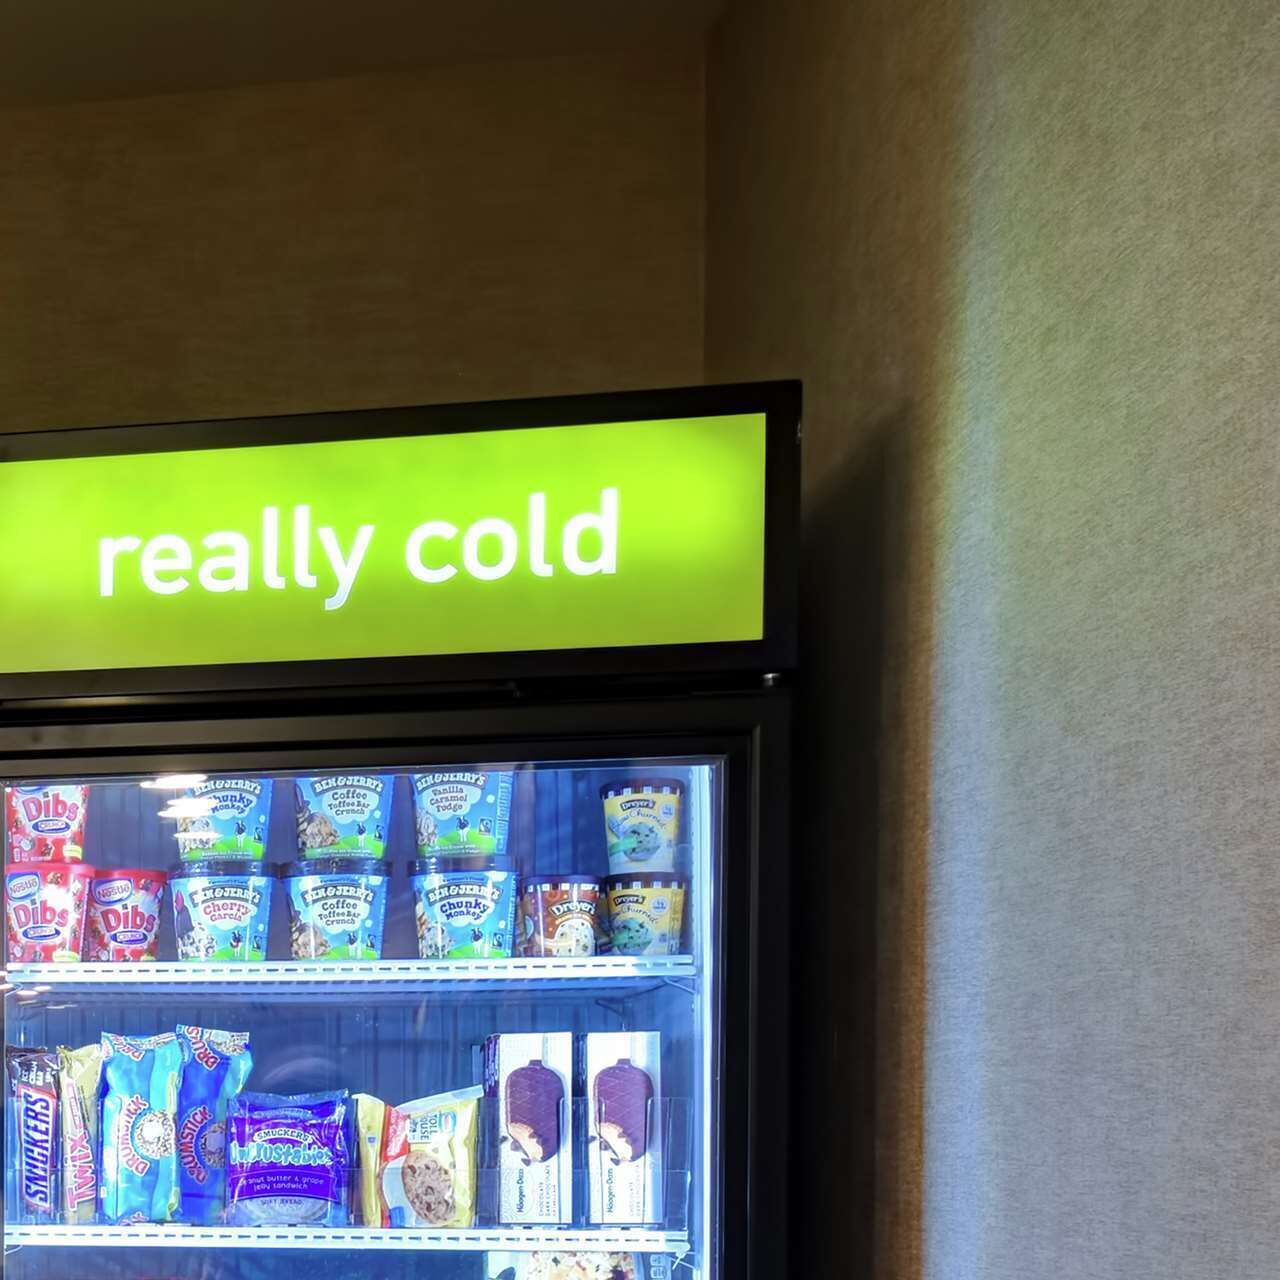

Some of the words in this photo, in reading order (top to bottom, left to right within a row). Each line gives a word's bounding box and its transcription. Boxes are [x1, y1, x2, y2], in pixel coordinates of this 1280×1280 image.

[98, 504, 376, 611] really
[405, 487, 618, 583] cold
[332, 790, 368, 800] Coffee
[432, 786, 464, 796] Vanilla
[328, 800, 356, 809] Toffee
[430, 794, 468, 805] Caramel
[23, 792, 80, 821] Dibs
[436, 803, 463, 813] Fudge
[202, 903, 251, 916] Cherry
[322, 900, 358, 910] Coffee
[440, 900, 489, 913] Chunky
[552, 902, 595, 916] Dreyer's
[13, 903, 70, 928] Dibs
[100, 904, 157, 933] Dibs
[210, 912, 242, 923] Garcia
[446, 909, 482, 921] Monkey
[325, 918, 356, 926] Crunch
[24, 1094, 50, 1206] SNICKERS
[67, 1132, 95, 1210] TWIX
